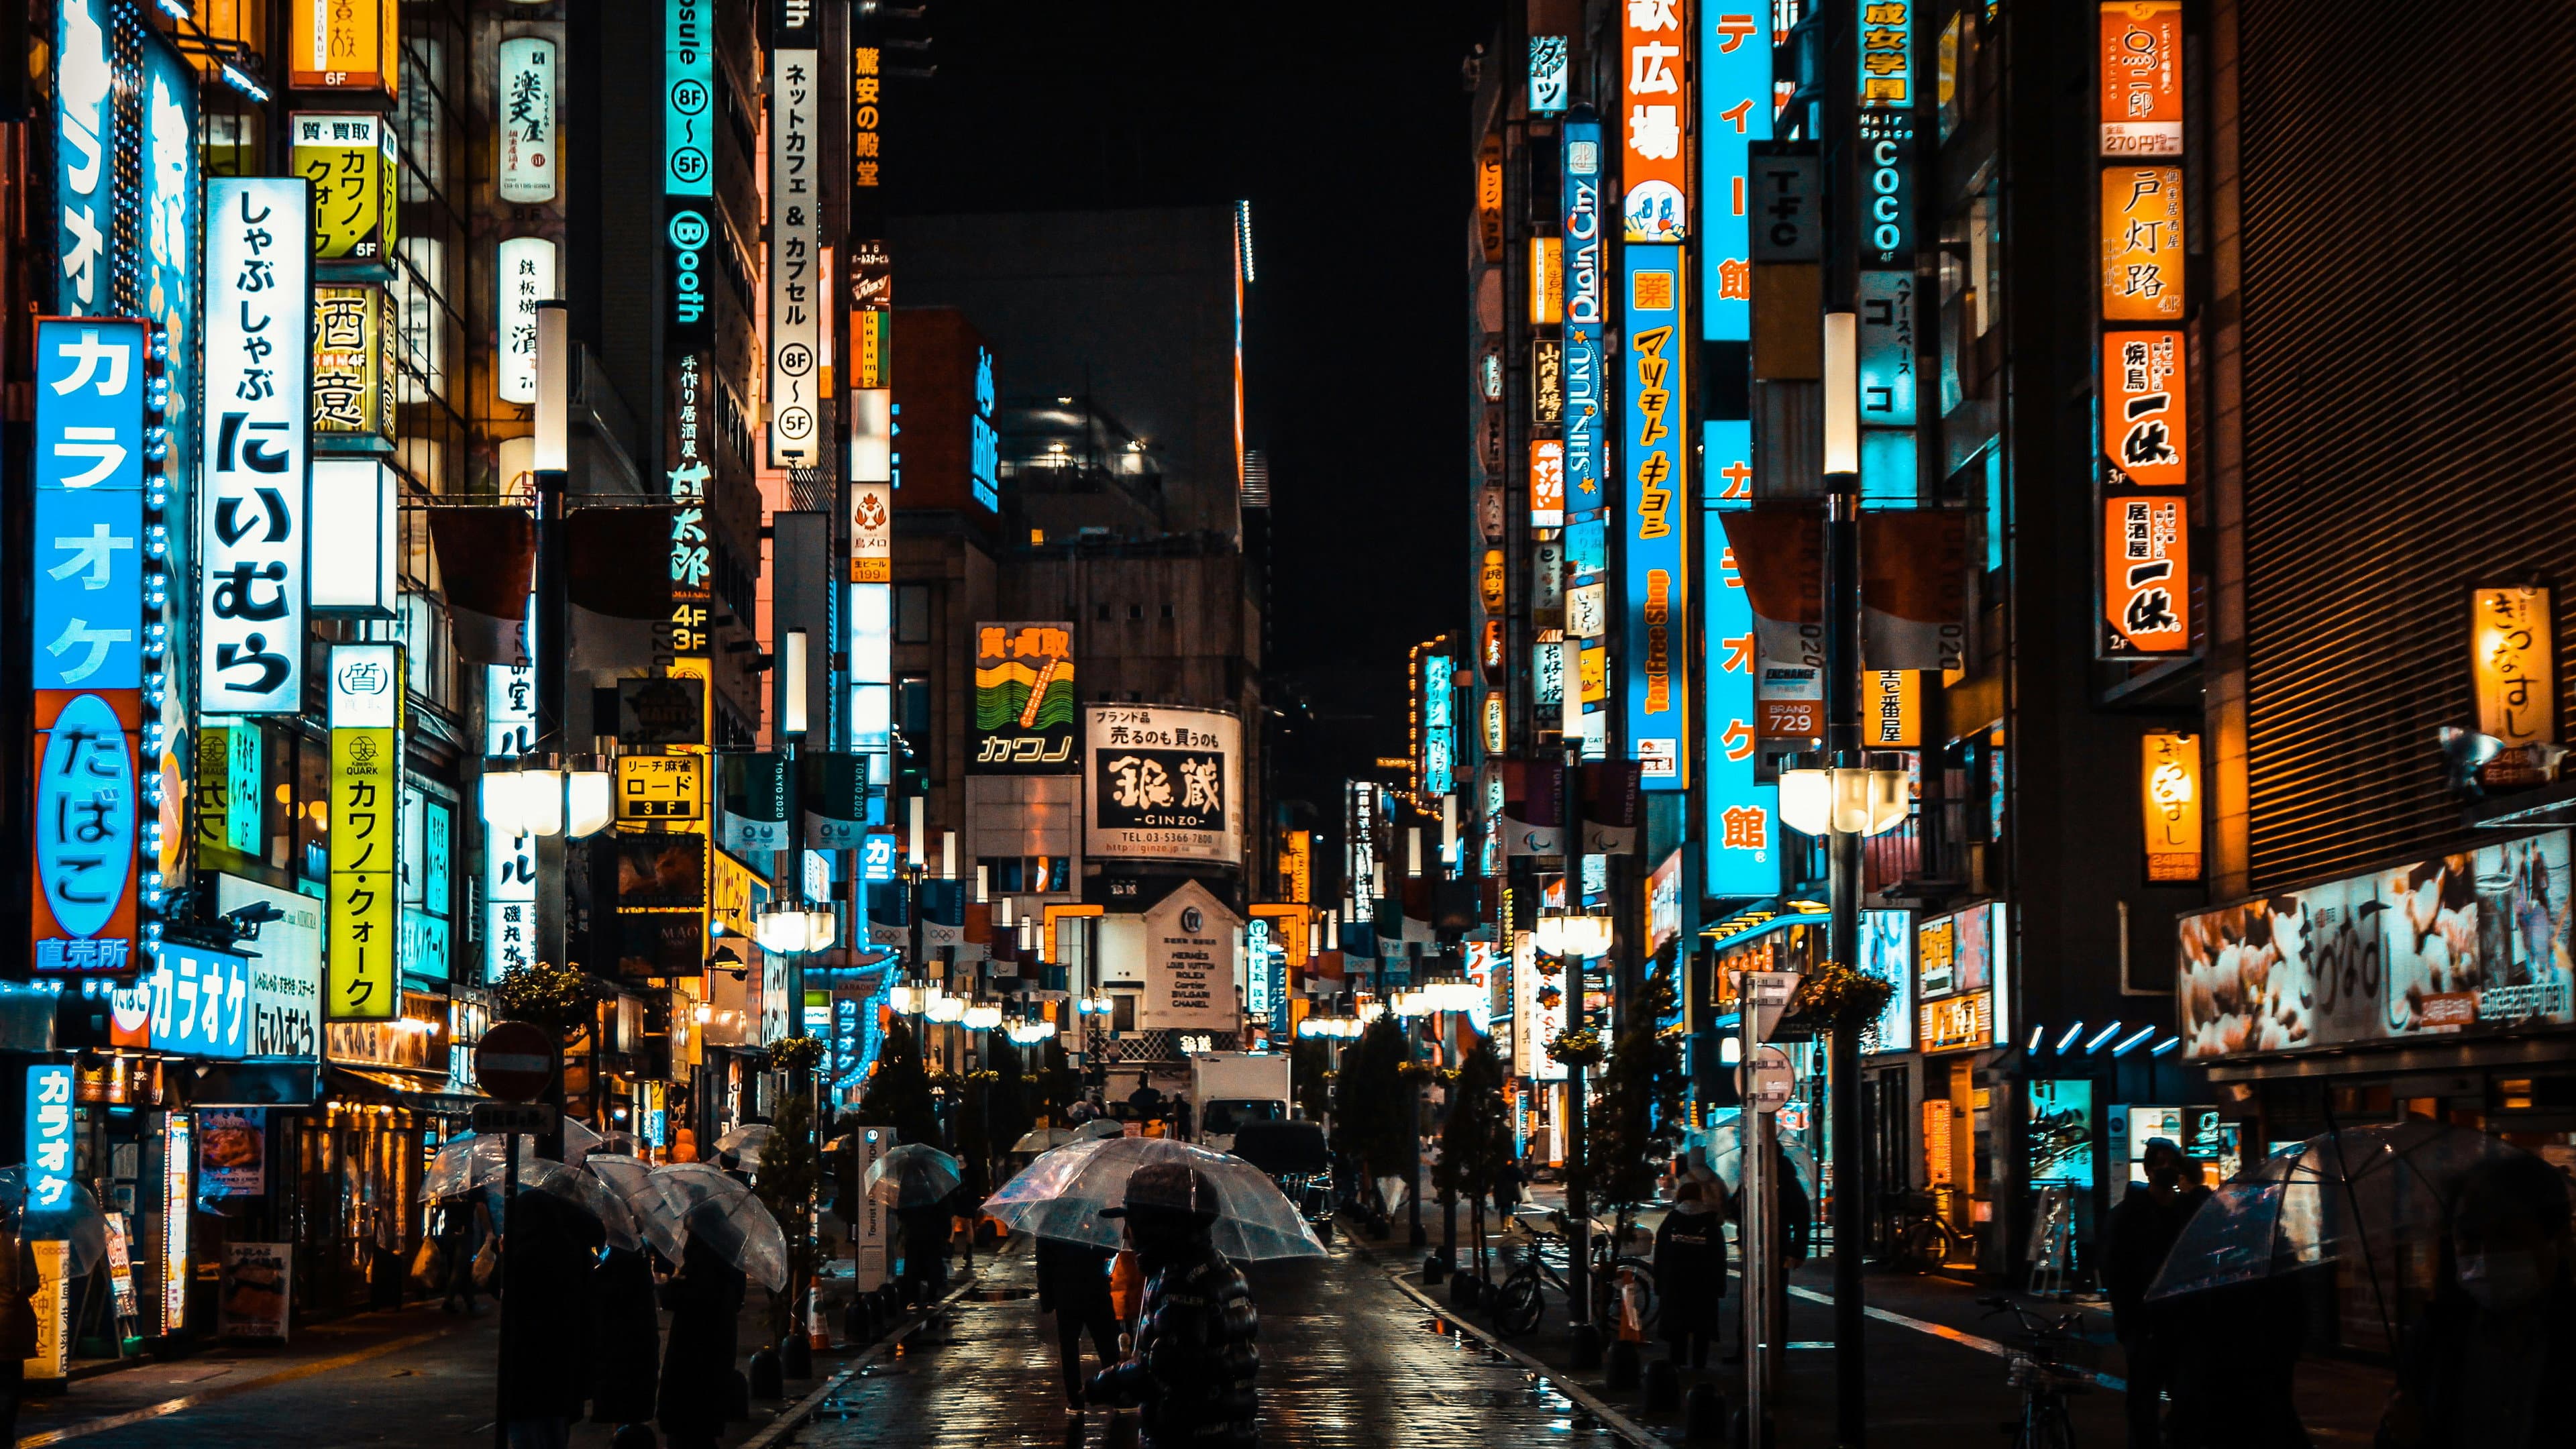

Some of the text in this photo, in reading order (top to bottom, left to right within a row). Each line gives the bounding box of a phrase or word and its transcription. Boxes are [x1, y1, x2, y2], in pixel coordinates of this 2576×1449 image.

[325, 72, 347, 85] 6F
[1533, 40, 1560, 105] ダーツ
[303, 122, 370, 141] 質・買取
[785, 64, 806, 195] ネットカフェ
[855, 47, 879, 186] 驚安の殿堂
[1860, 113, 1902, 125] Hair
[1860, 127, 1914, 139] Space
[1873, 140, 1900, 250] COCO
[2165, 169, 2180, 249] 個室居酒屋
[356, 244, 376, 256] 5F
[236, 191, 274, 400] しゃぶしゃぶ
[785, 237, 807, 327] カプセル
[1897, 277, 1911, 376] ヘアースペース
[348, 354, 365, 366] 4F
[1538, 343, 1562, 412] 山内農場
[2124, 341, 2149, 392] 焼鳥
[681, 355, 698, 459] 手作り居酒屋
[1633, 326, 1674, 539] マツモトキヨシ
[2122, 392, 2174, 467] 一休
[2108, 469, 2127, 484] 3F
[46, 328, 133, 684] カラオケ
[667, 461, 710, 588] 甘太郎
[2127, 502, 2150, 559] 居酒屋
[213, 411, 292, 694] にいむら
[673, 604, 707, 627] 4F
[1645, 570, 1670, 624] Shop
[2125, 560, 2176, 635] 一休
[673, 629, 706, 651] 3F
[2110, 635, 2129, 649] 2F
[1645, 673, 1670, 714] Tax
[1766, 669, 1815, 680] EXCHANGE
[1096, 711, 1150, 723] ブランド品
[1770, 705, 1811, 714] BRAND
[1770, 714, 1812, 731] 729
[977, 736, 1073, 763] カワノ
[1111, 726, 1219, 747] 売るのも 買うのも
[346, 767, 378, 775] QUARK
[627, 775, 692, 797] ロード
[629, 759, 692, 773] リーチ麻雀
[1109, 755, 1220, 814] 銀蔵
[54, 722, 121, 904] たばこ
[775, 795, 784, 818] 2020
[854, 794, 863, 818] 2020
[36, 938, 129, 969] 直売所
[150, 953, 246, 1045] カラオケ
[255, 1003, 314, 1055] にいむら
[839, 1000, 856, 1069] カラオケ
[38, 1071, 69, 1205] カラオケ
